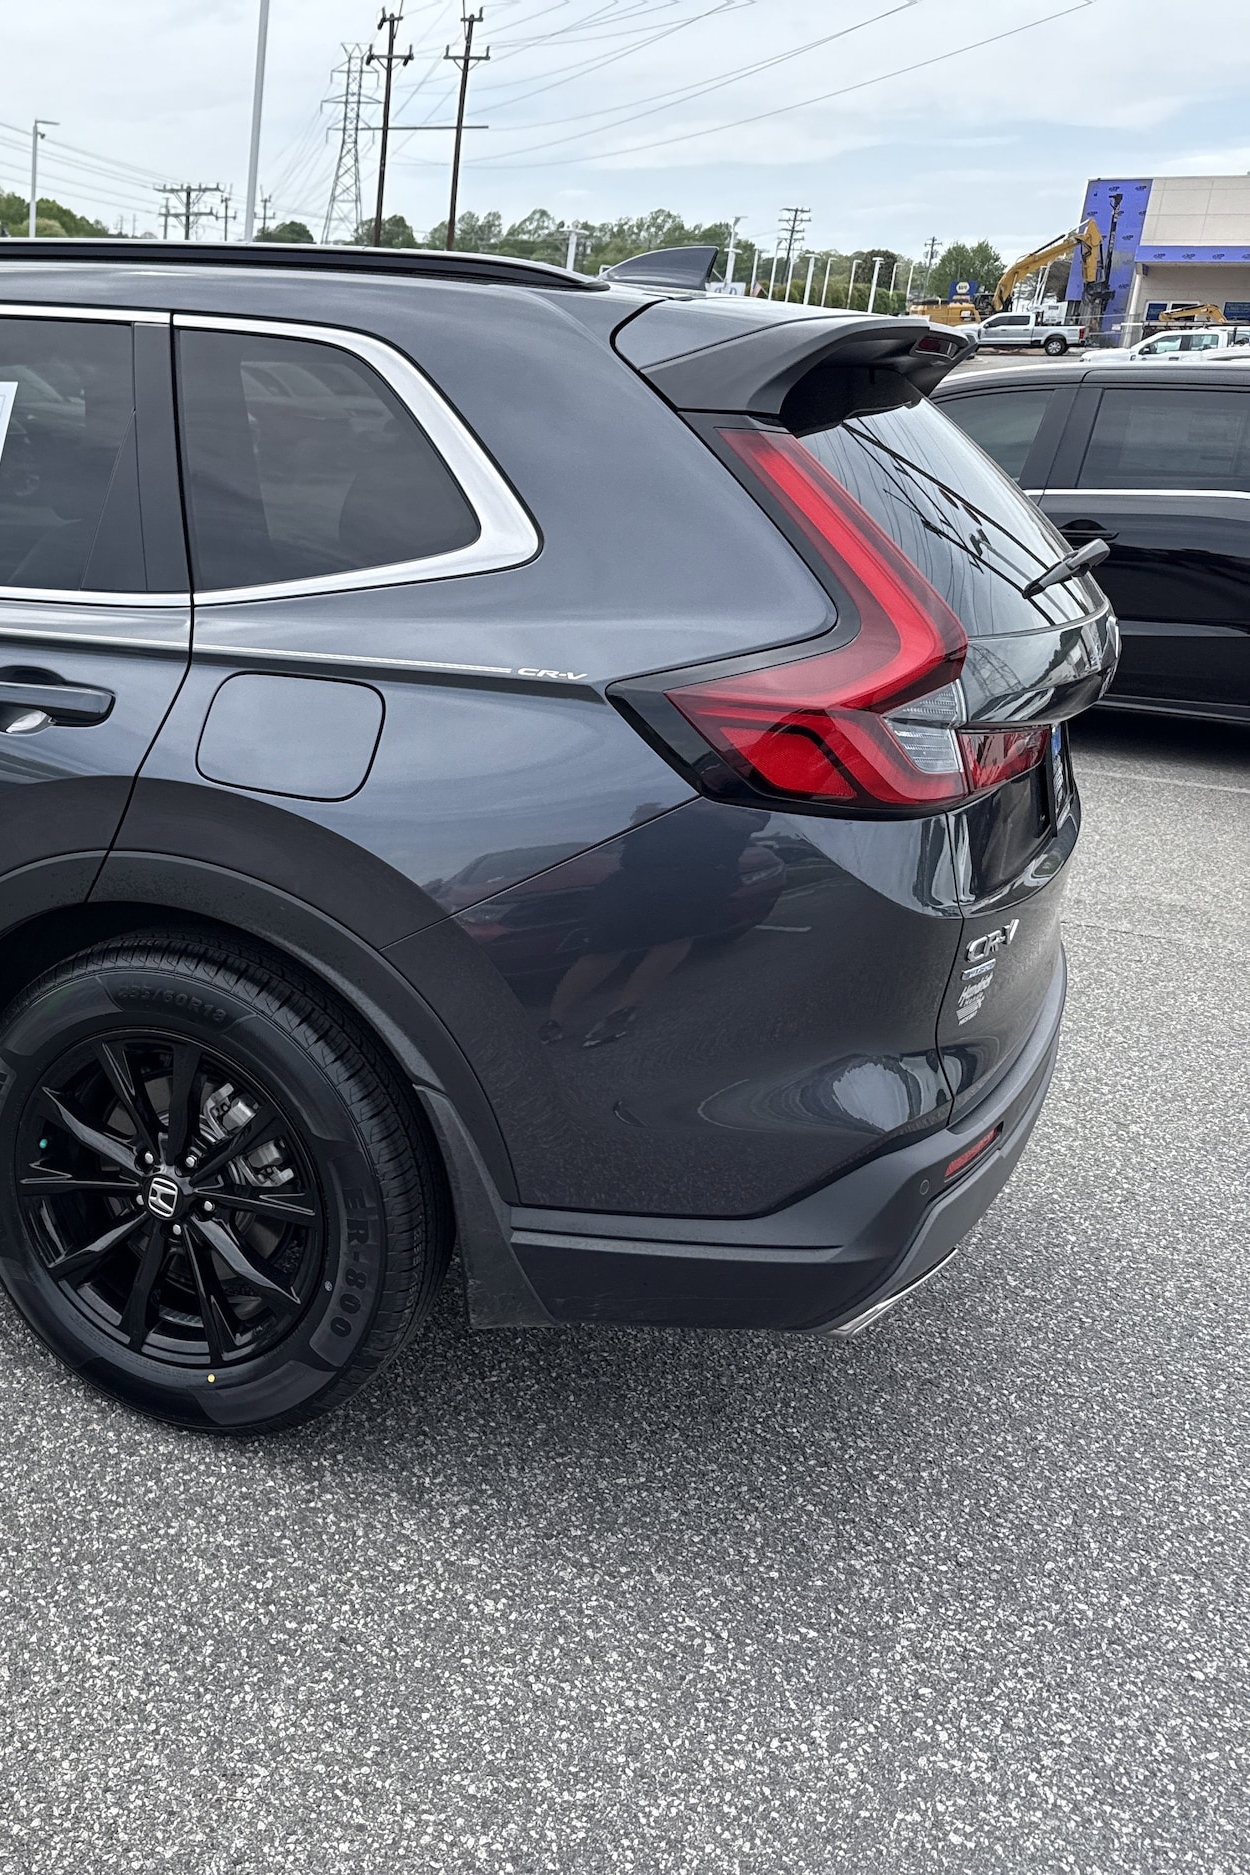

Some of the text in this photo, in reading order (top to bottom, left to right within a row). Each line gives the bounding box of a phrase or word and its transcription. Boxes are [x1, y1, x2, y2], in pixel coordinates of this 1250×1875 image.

[517, 667, 588, 680] CR-V
[966, 919, 1019, 962] CR-V
[118, 984, 227, 1023] 235/60R18
[330, 1187, 370, 1338] ER-800
